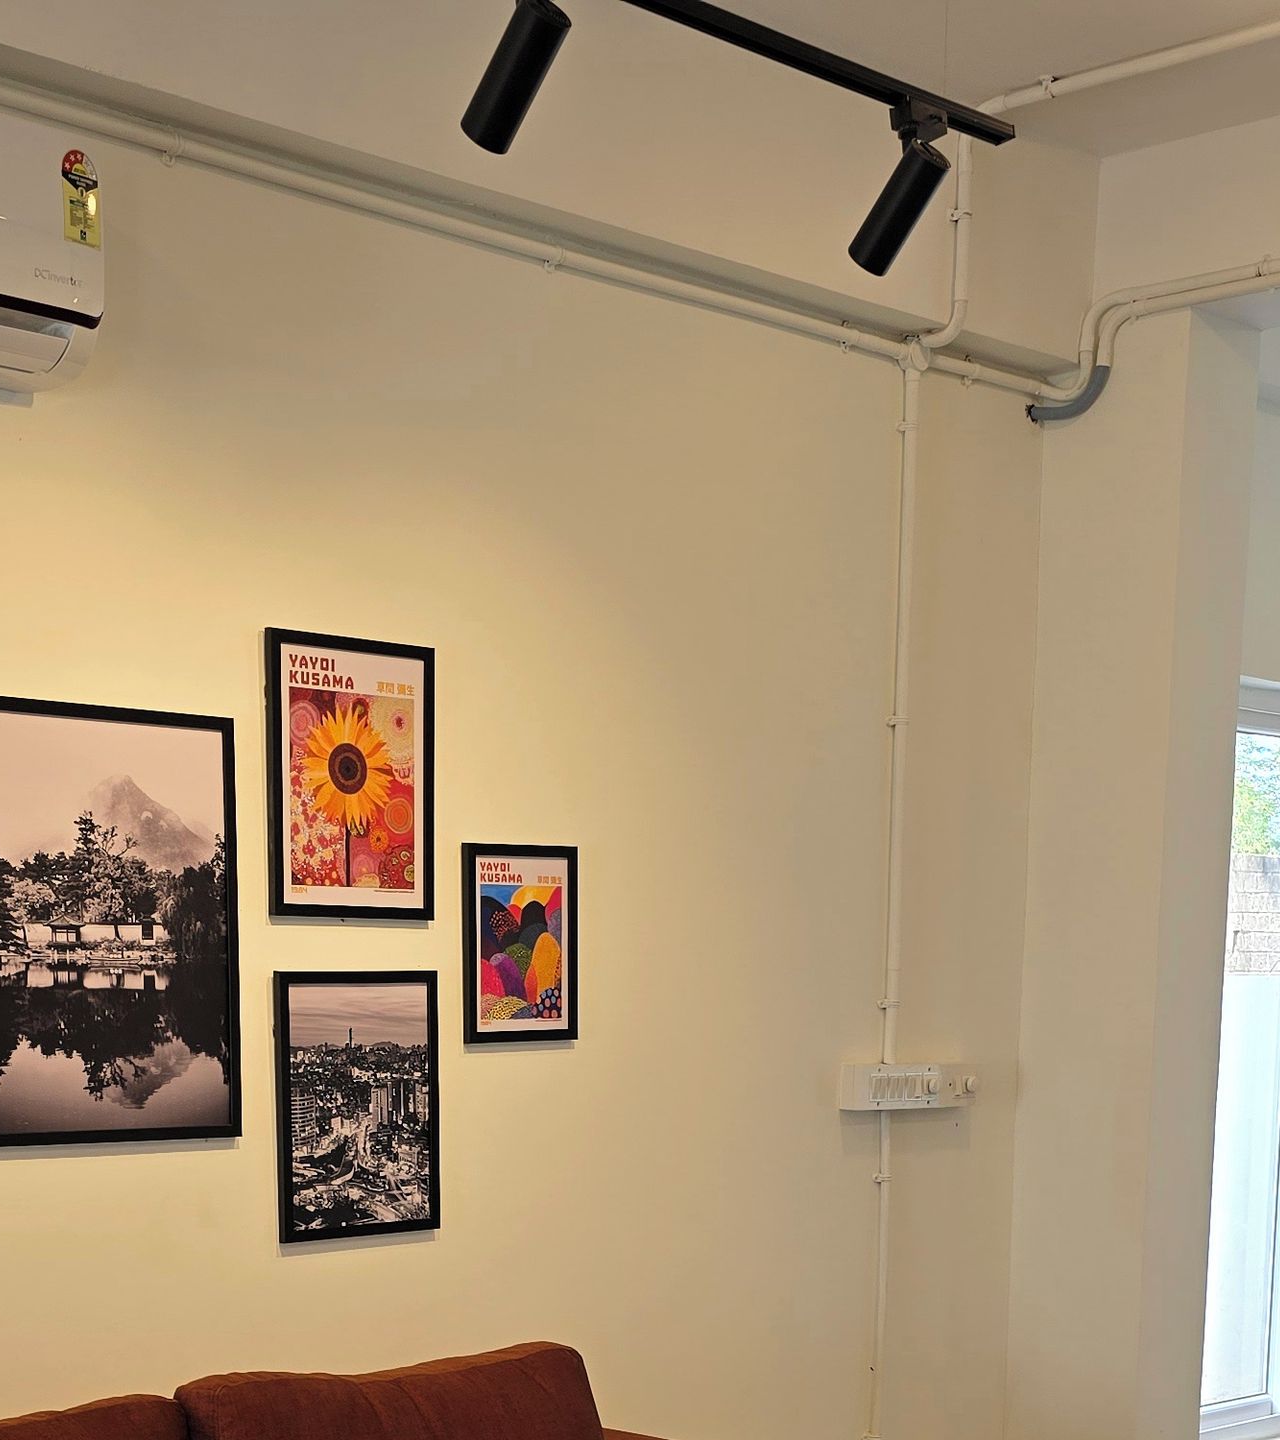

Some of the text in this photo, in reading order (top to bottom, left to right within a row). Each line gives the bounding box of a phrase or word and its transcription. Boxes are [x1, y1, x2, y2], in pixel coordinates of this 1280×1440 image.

[289, 653, 336, 672] YAYOI
[289, 670, 354, 689] KUSAMA
[480, 861, 510, 873] YAYOI
[480, 873, 523, 883] KUSAMA
